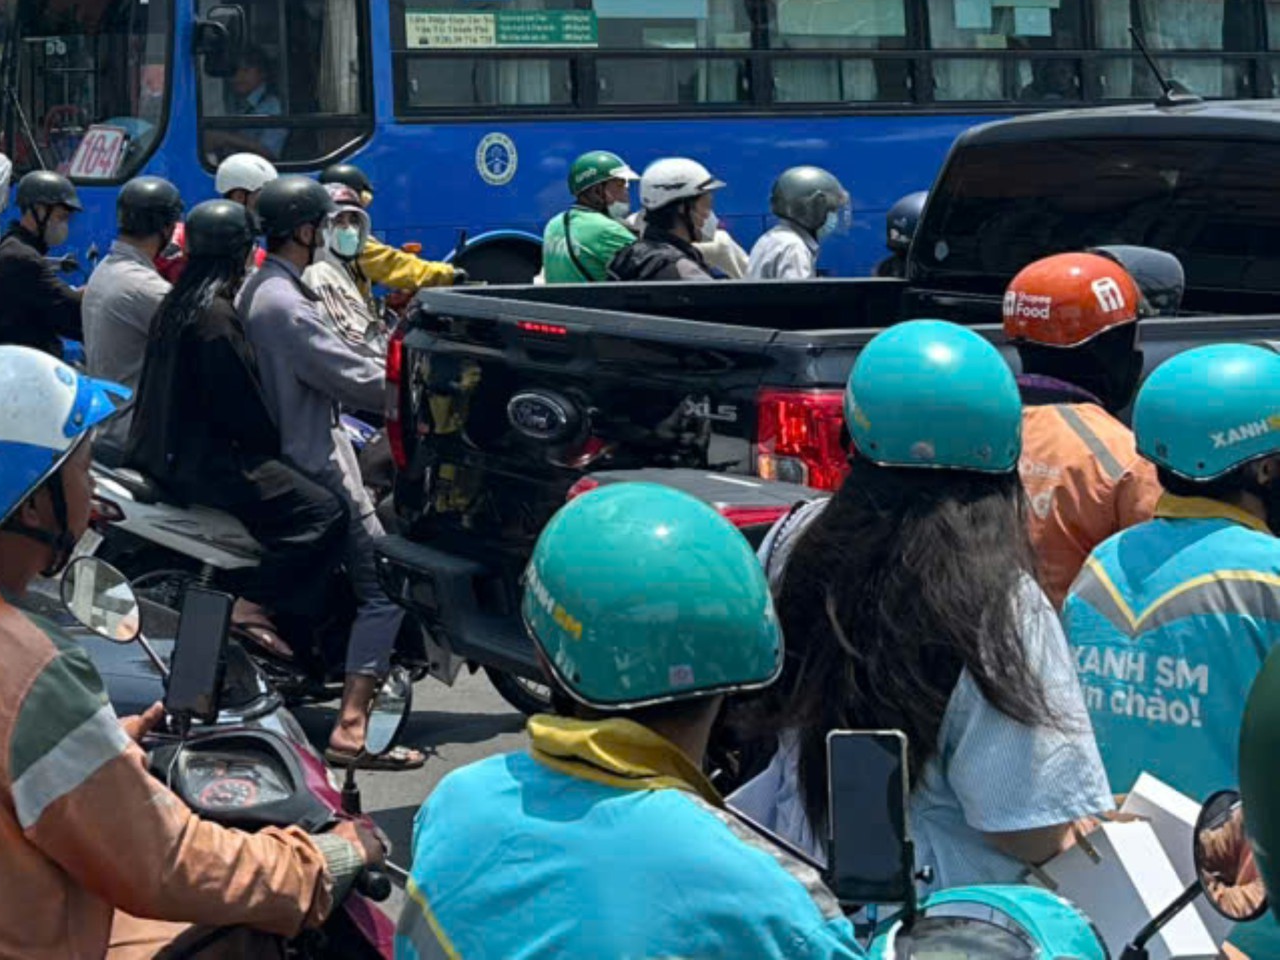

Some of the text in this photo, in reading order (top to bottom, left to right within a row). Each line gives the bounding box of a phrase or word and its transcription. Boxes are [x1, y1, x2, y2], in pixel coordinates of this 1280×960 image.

[77, 133, 120, 174] 104
[1017, 302, 1051, 320] Food
[1210, 419, 1269, 449] XANH
[1155, 656, 1209, 695] SM
[1111, 685, 1203, 728] chào!
